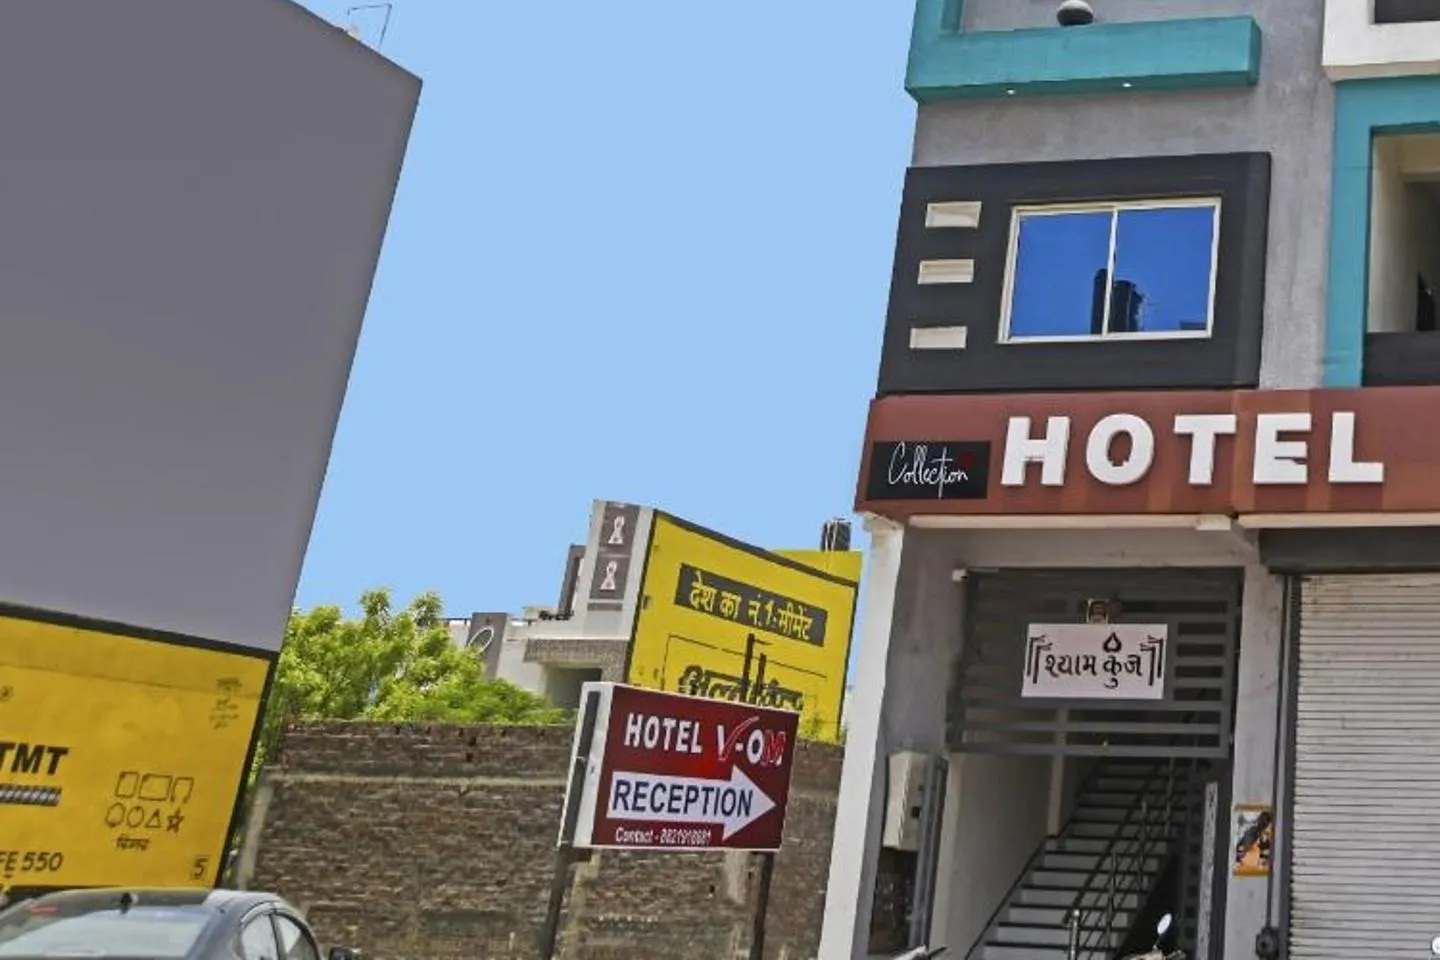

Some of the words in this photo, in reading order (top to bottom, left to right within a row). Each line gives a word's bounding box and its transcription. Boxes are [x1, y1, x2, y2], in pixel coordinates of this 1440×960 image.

[1000, 411, 1384, 486] HOTEL
[888, 441, 969, 498] Collection
[689, 571, 716, 613] देश
[719, 590, 742, 619] का
[623, 712, 704, 754] HOTEL
[0, 741, 69, 776] TMT
[612, 779, 753, 817] RECEPTION
[615, 826, 654, 844] Contact
[21, 851, 64, 872] 550
